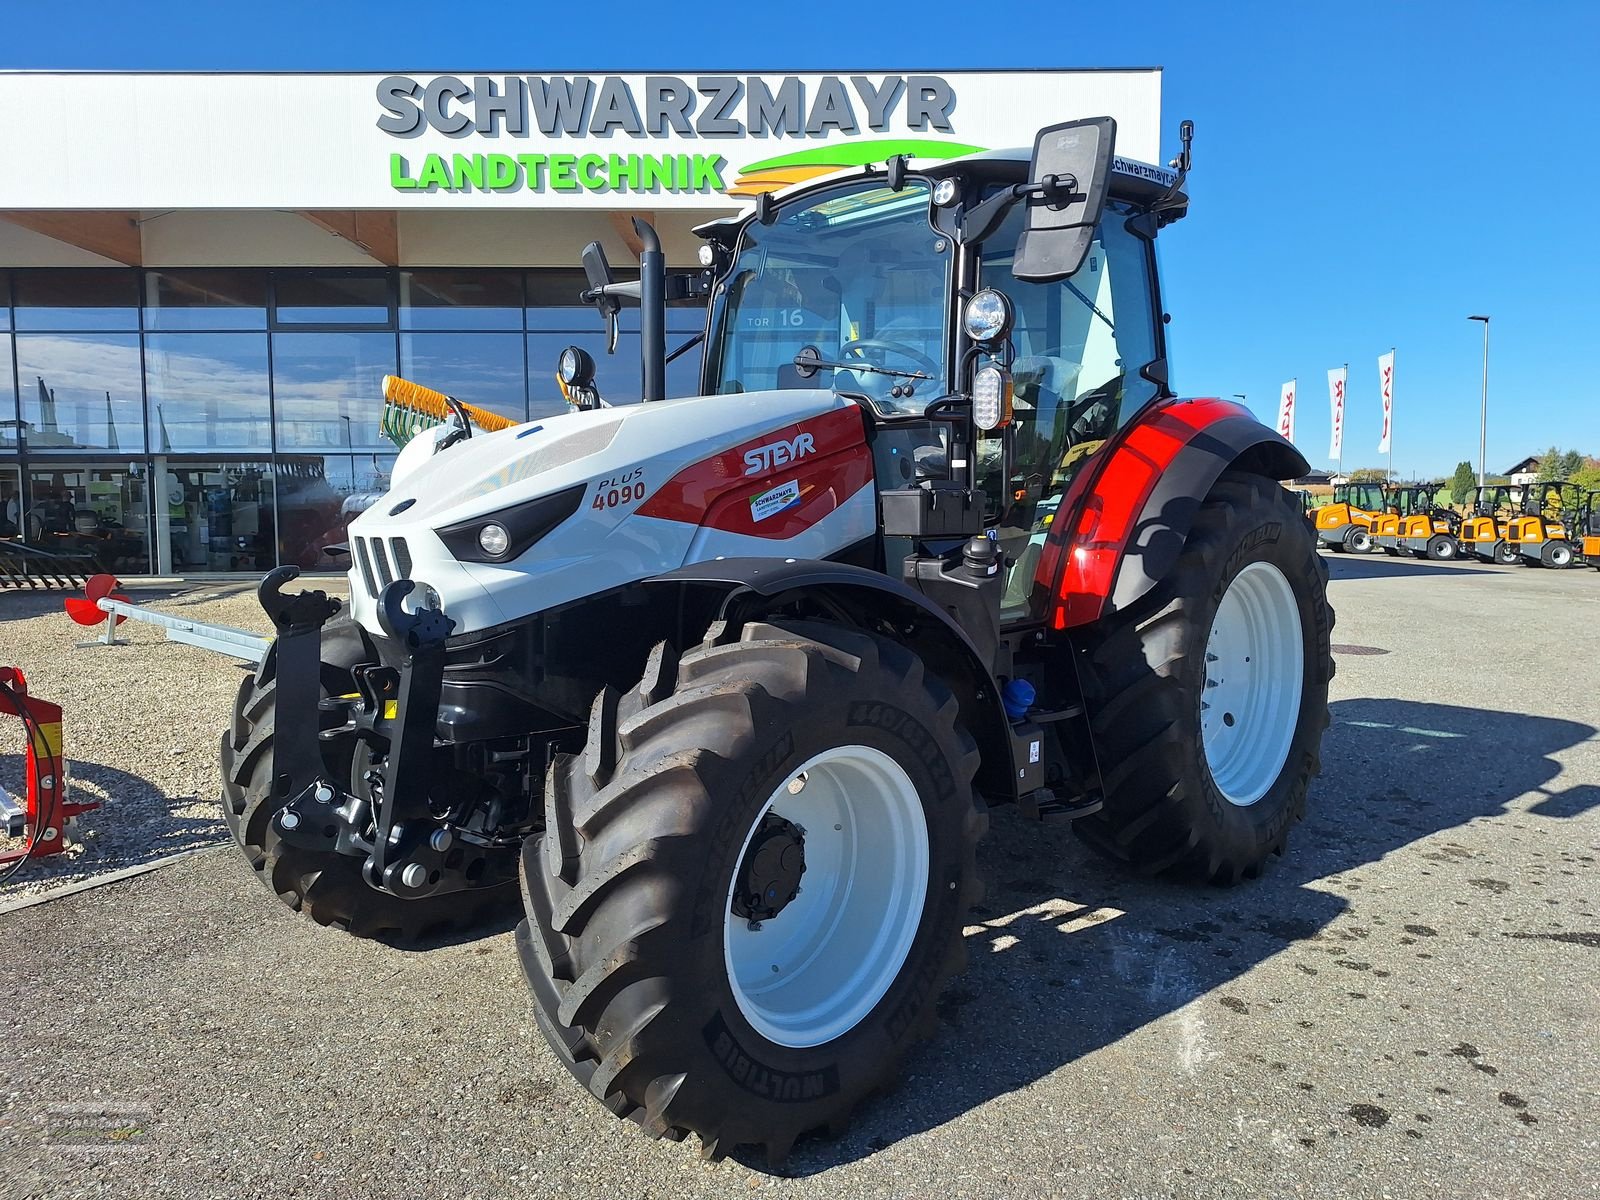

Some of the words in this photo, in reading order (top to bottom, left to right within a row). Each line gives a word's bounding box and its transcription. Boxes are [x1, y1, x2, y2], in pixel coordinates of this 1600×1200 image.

[375, 75, 956, 138] SCHWARZMAYR
[390, 153, 726, 192] LANDTECHNIK
[747, 317, 769, 327] TOR
[780, 309, 804, 327] 16
[743, 432, 816, 476] STEYR
[592, 481, 646, 511] 4090
[598, 467, 643, 492] PLUS
[755, 487, 793, 507] SCHWARZMAYR
[713, 1031, 825, 1099] MULTIBIB
